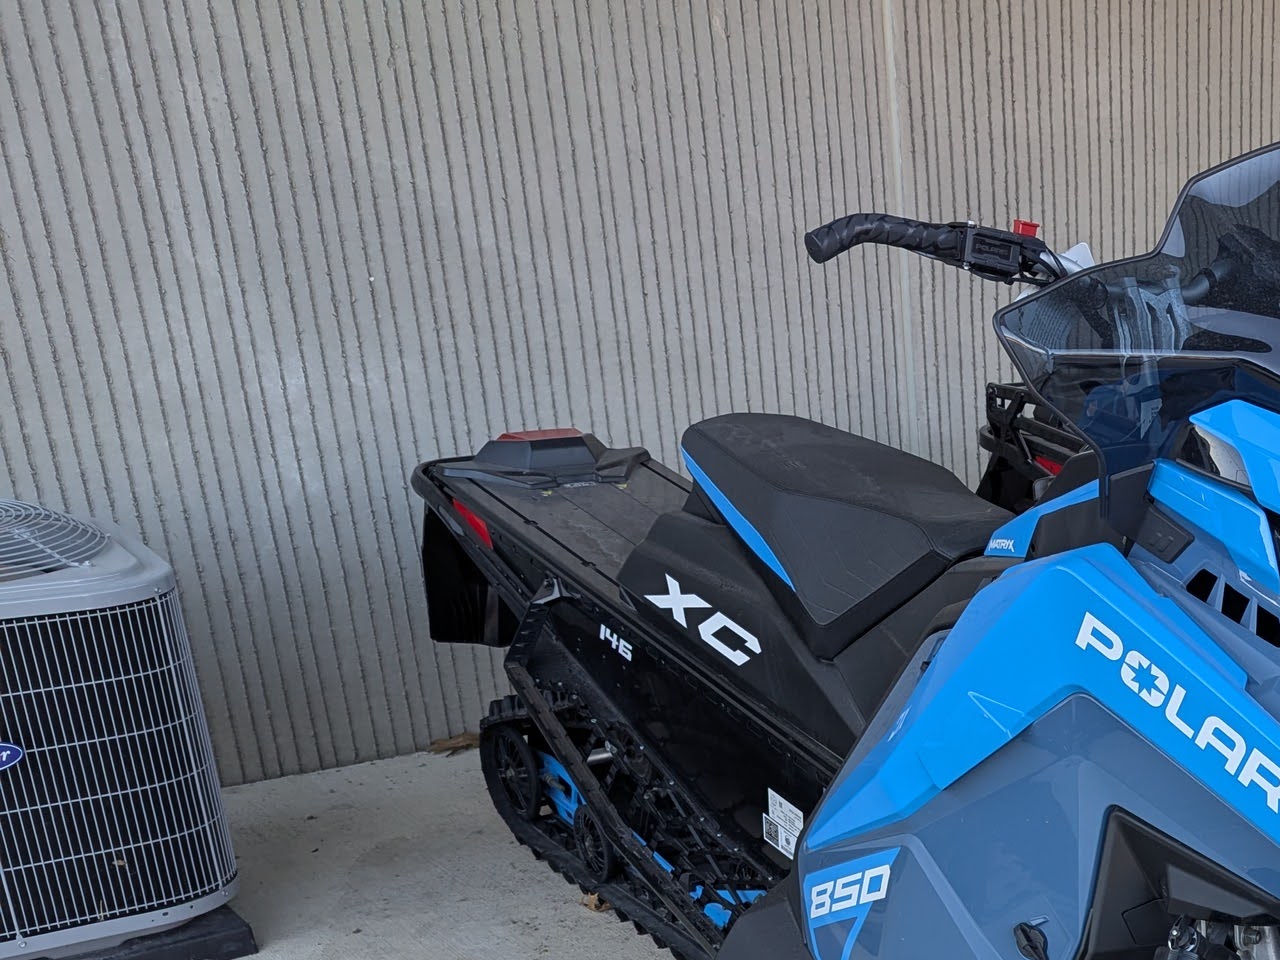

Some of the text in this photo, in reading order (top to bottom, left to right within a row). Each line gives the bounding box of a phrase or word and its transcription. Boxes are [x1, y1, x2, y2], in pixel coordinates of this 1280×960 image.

[988, 538, 1015, 552] MATRYX
[599, 623, 633, 662] 146
[644, 573, 762, 666] XC
[810, 864, 891, 919] 850
